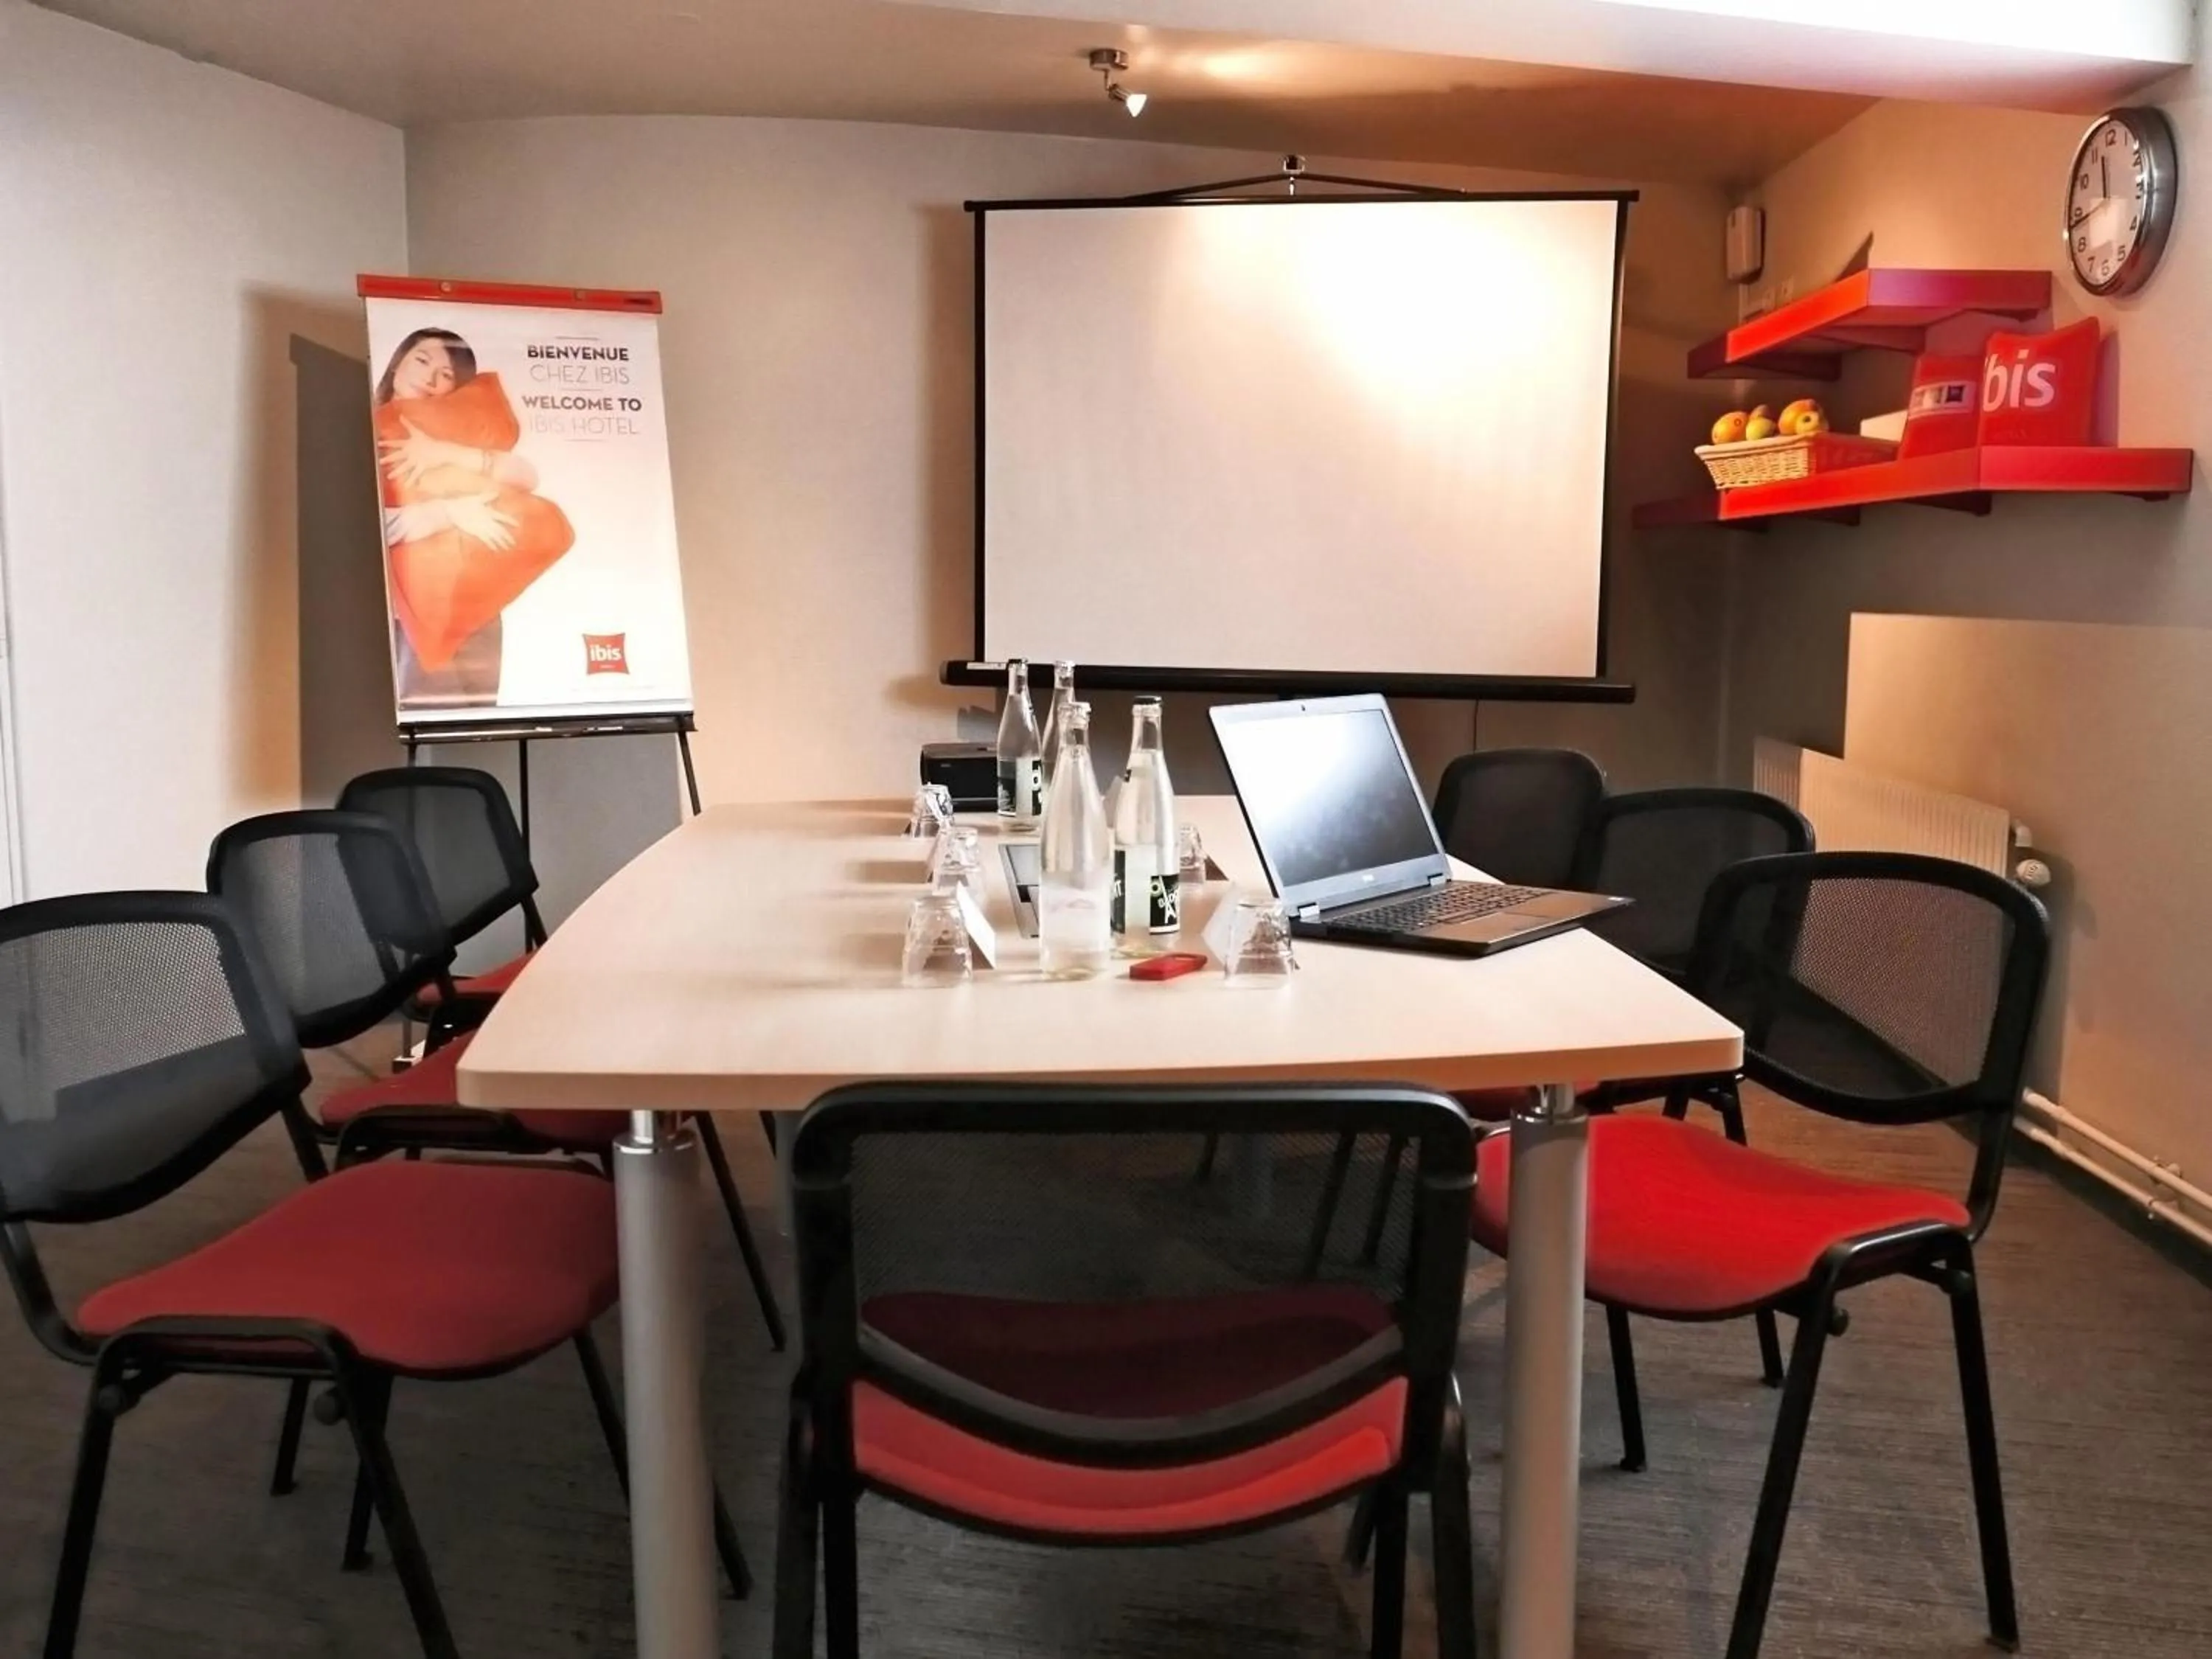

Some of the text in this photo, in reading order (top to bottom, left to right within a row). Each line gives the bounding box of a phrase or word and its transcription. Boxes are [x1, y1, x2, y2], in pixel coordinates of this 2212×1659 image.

[2105, 128, 2116, 147] 12
[2092, 148, 2098, 164] 11
[2079, 173, 2089, 190] 10
[2078, 237, 2086, 253] 8
[2118, 245, 2126, 262] 5
[2087, 255, 2096, 273] 7
[2101, 259, 2110, 276] 6
[527, 345, 629, 361] BIENVENUE
[530, 364, 630, 385] CHEZ IBIS
[1983, 349, 2056, 412] bis
[522, 396, 642, 411] WELCOME TO
[529, 416, 640, 435] IBIS HOTEL
[590, 644, 622, 661] ibis
